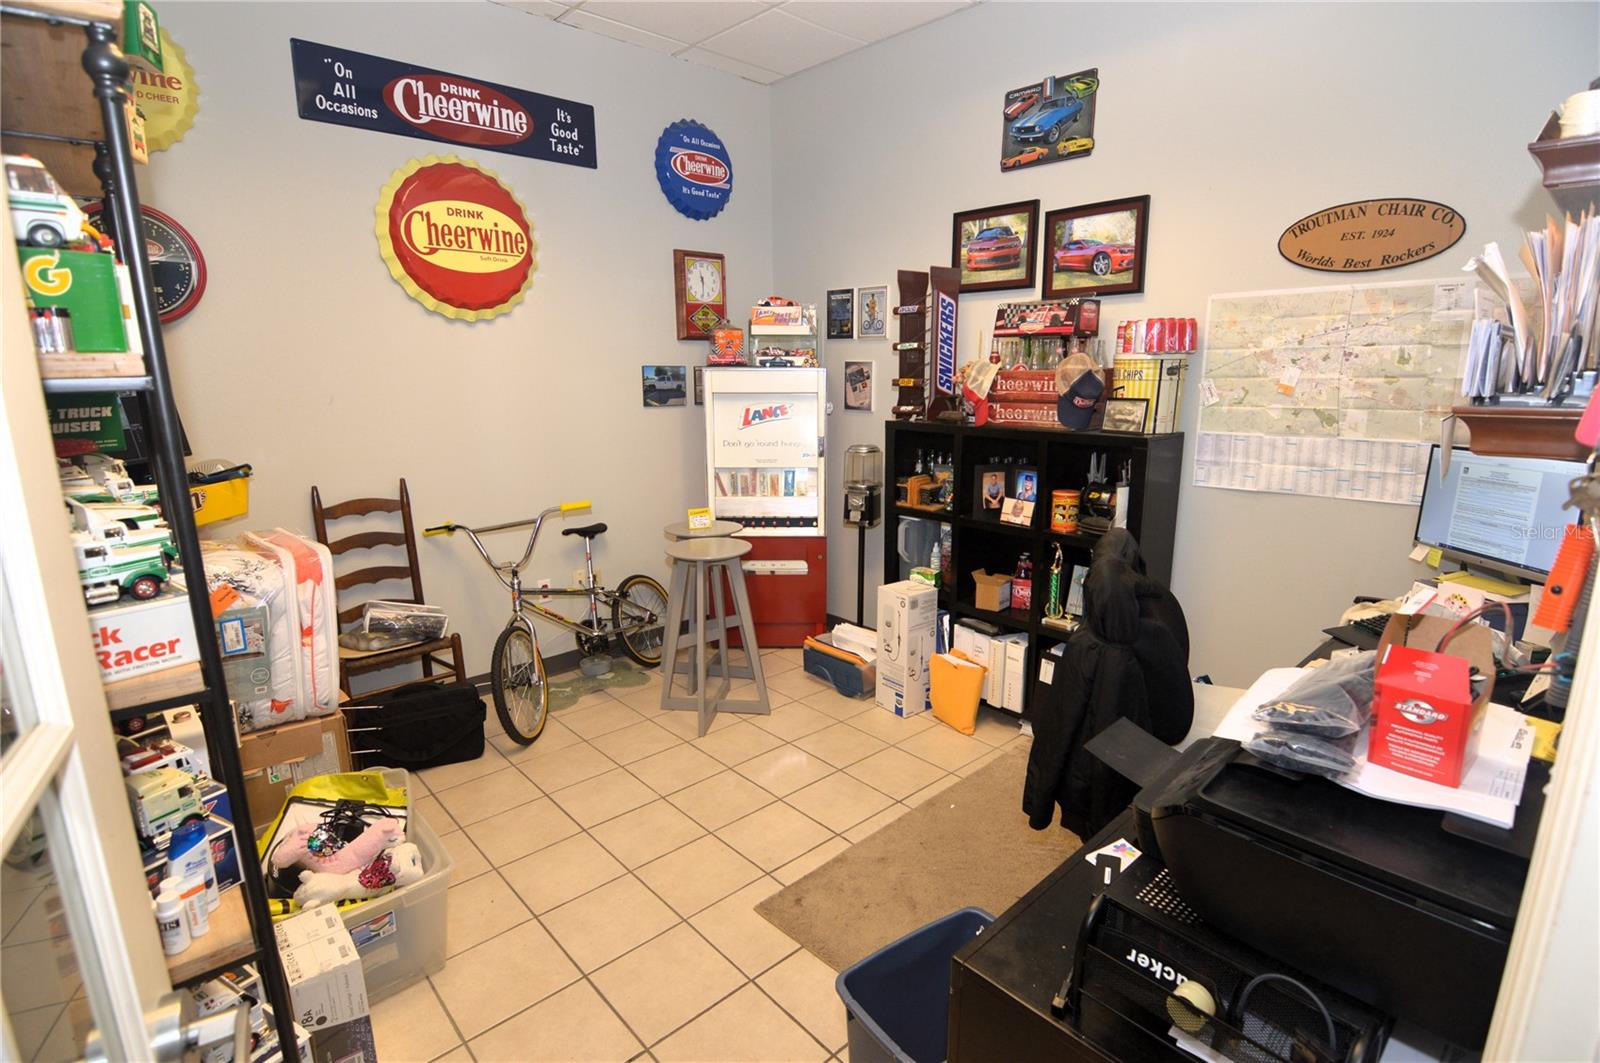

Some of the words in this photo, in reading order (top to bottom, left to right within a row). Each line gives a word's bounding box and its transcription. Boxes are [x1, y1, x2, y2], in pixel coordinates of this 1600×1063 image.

[145, 92, 180, 105] CHEER
[332, 82, 357, 100] All
[440, 82, 480, 100] DRINK
[1008, 86, 1042, 99] CAMARO
[315, 94, 379, 119] Occasions
[393, 78, 528, 135] Cheerwine
[556, 108, 572, 124] It's
[550, 123, 578, 141] Good
[691, 137, 700, 145] All
[676, 155, 726, 179] Cheerwine
[691, 186, 705, 197] Good
[446, 206, 484, 221] DRINK
[1287, 205, 1368, 240] TROUTMAN
[1377, 202, 1427, 217] CHAIR
[1431, 207, 1456, 228] CO.
[404, 209, 526, 257] Cheerwine
[1339, 230, 1366, 242] EST.
[1371, 227, 1396, 240] 1924
[480, 255, 492, 263] Soft
[492, 256, 509, 264] Drink
[1296, 247, 1336, 269] Worlds
[1342, 256, 1371, 269] Best
[1380, 241, 1436, 266] Rockers
[936, 297, 955, 391] SNICKERS
[1123, 369, 1144, 381] CHIPS
[990, 374, 1058, 395] heerwin
[57, 406, 113, 419] TRUCK
[742, 403, 790, 427] LANCE
[988, 402, 1059, 423] Cheerwin
[52, 420, 101, 434] UISER
[722, 439, 742, 448] Don't
[744, 440, 754, 449] go
[96, 637, 181, 670] Racer
[1393, 701, 1448, 722] STANDARD
